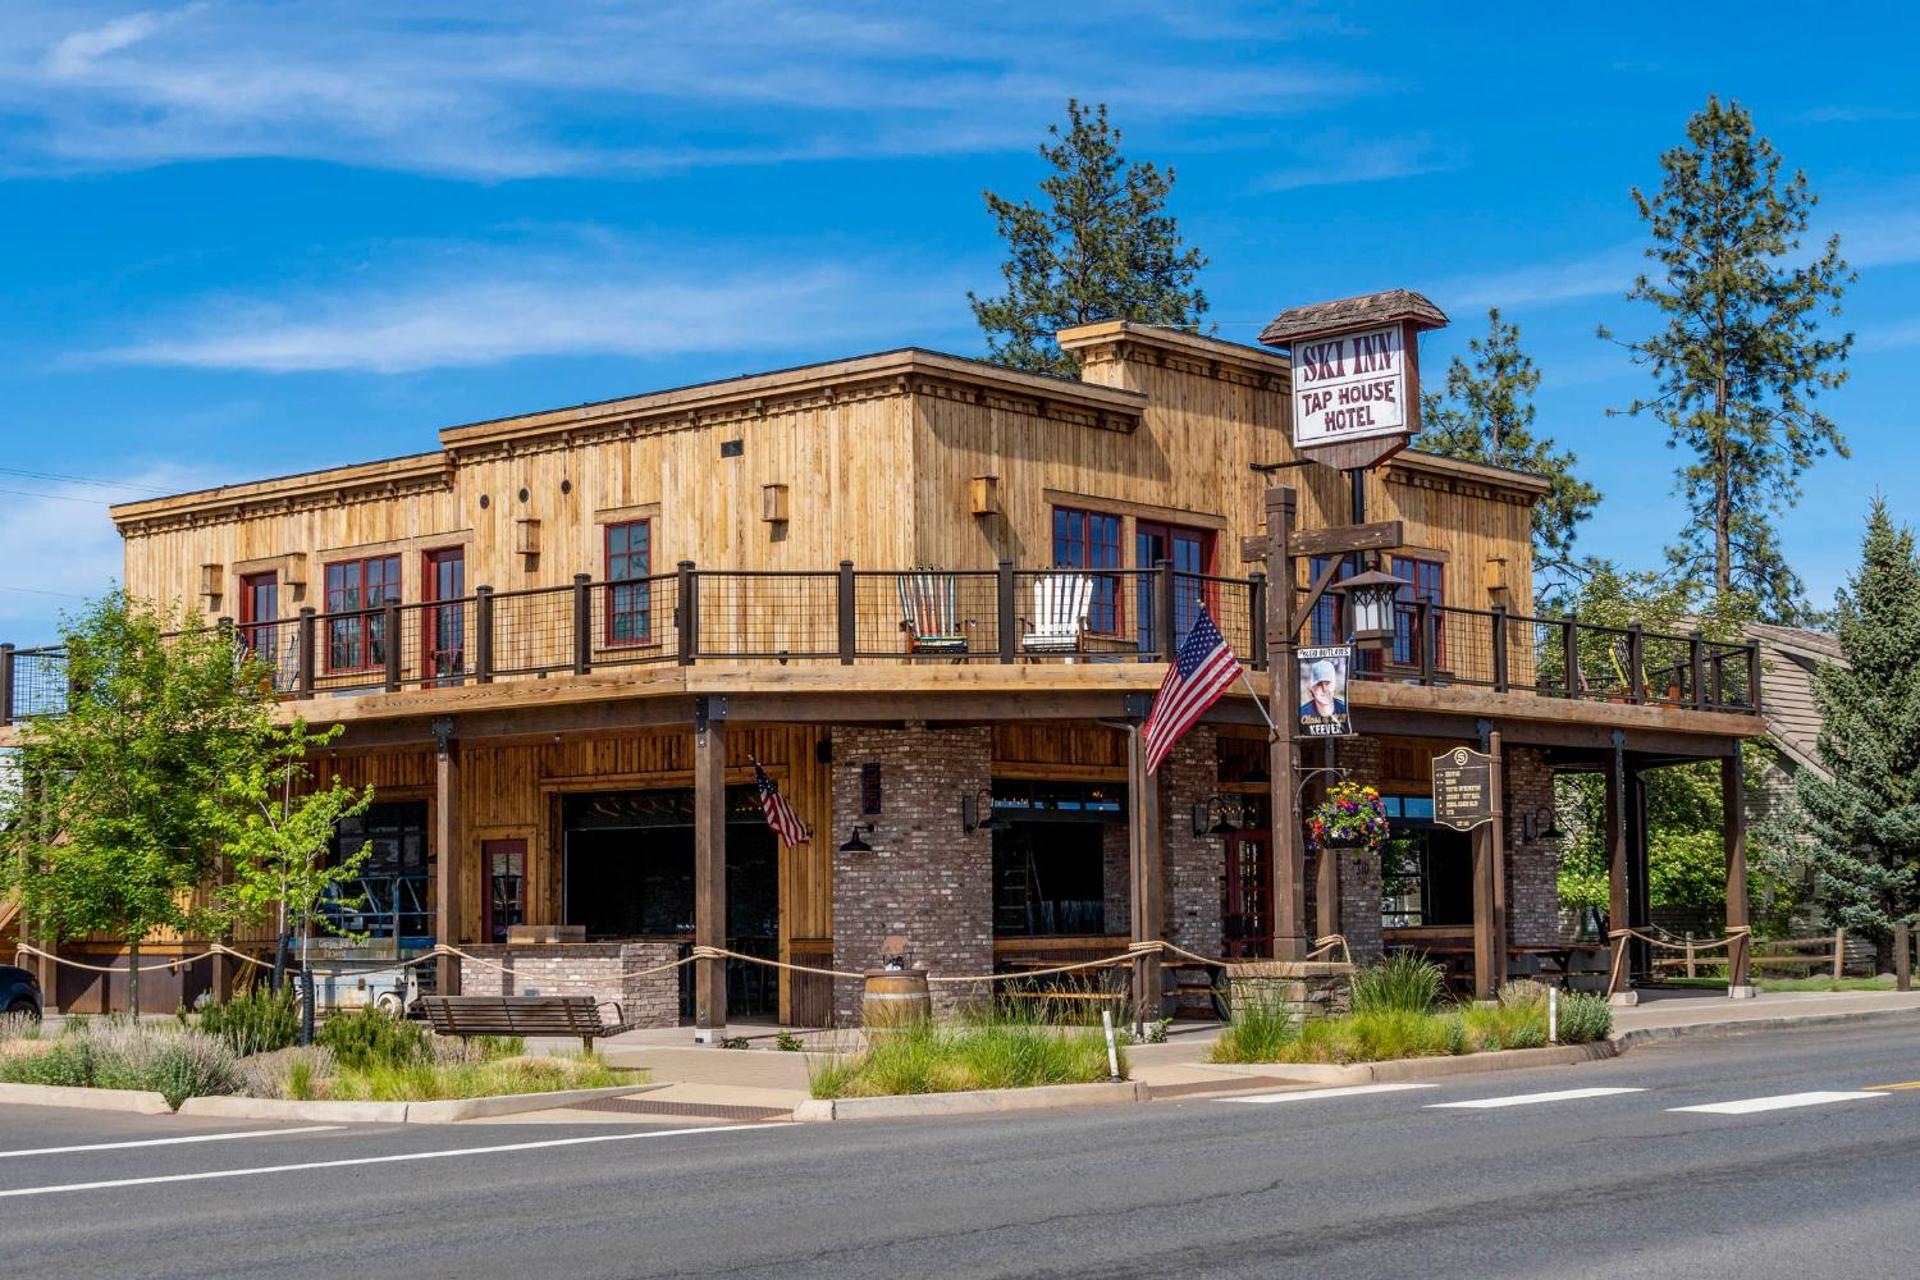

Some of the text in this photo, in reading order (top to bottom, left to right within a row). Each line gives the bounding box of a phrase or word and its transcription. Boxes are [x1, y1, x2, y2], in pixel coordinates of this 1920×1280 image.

[1302, 331, 1393, 383] SKI INN
[1301, 380, 1396, 417] TAP HOUSE
[1324, 405, 1375, 432] HOTEL
